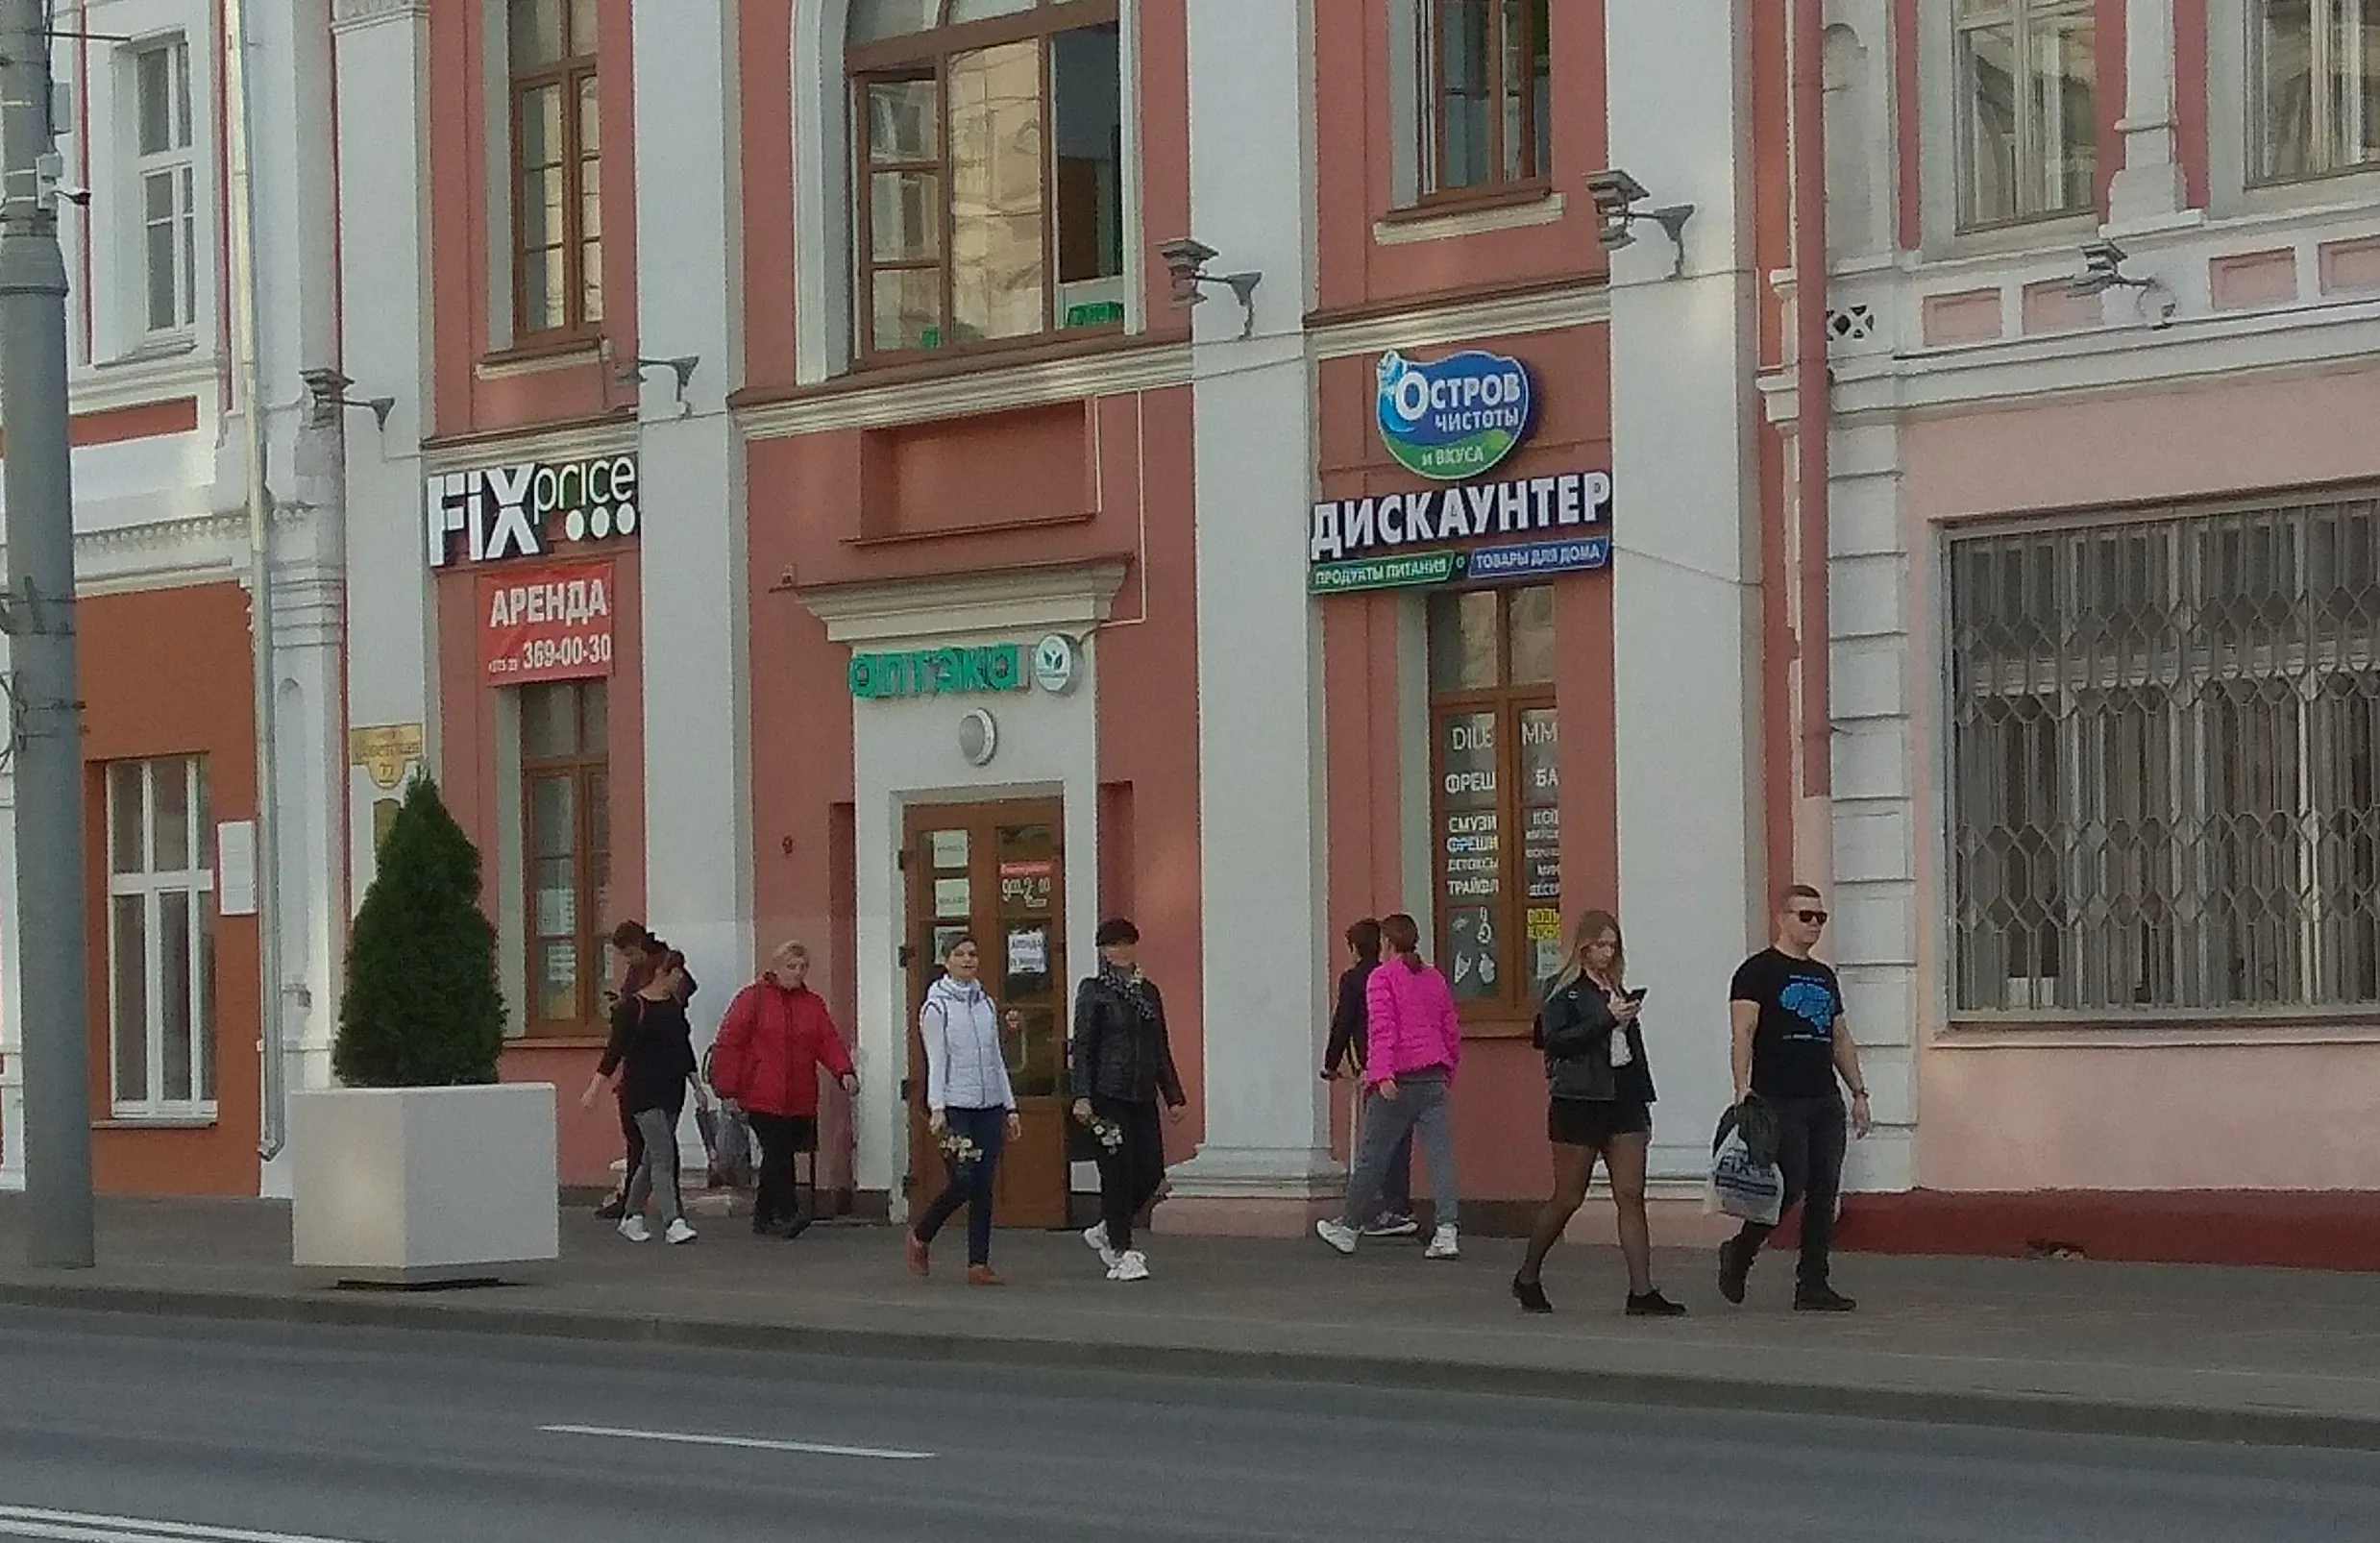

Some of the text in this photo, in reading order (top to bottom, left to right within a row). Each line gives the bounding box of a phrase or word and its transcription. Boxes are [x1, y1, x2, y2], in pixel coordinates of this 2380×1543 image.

[1435, 406, 1519, 432] ЧИСТОТЫ
[1311, 471, 1610, 561] ДИСКАУНТЕР
[1476, 551, 1529, 569] ТОВАРЫ
[1560, 544, 1601, 565] ДОМА
[489, 578, 607, 627] АРЕНДА
